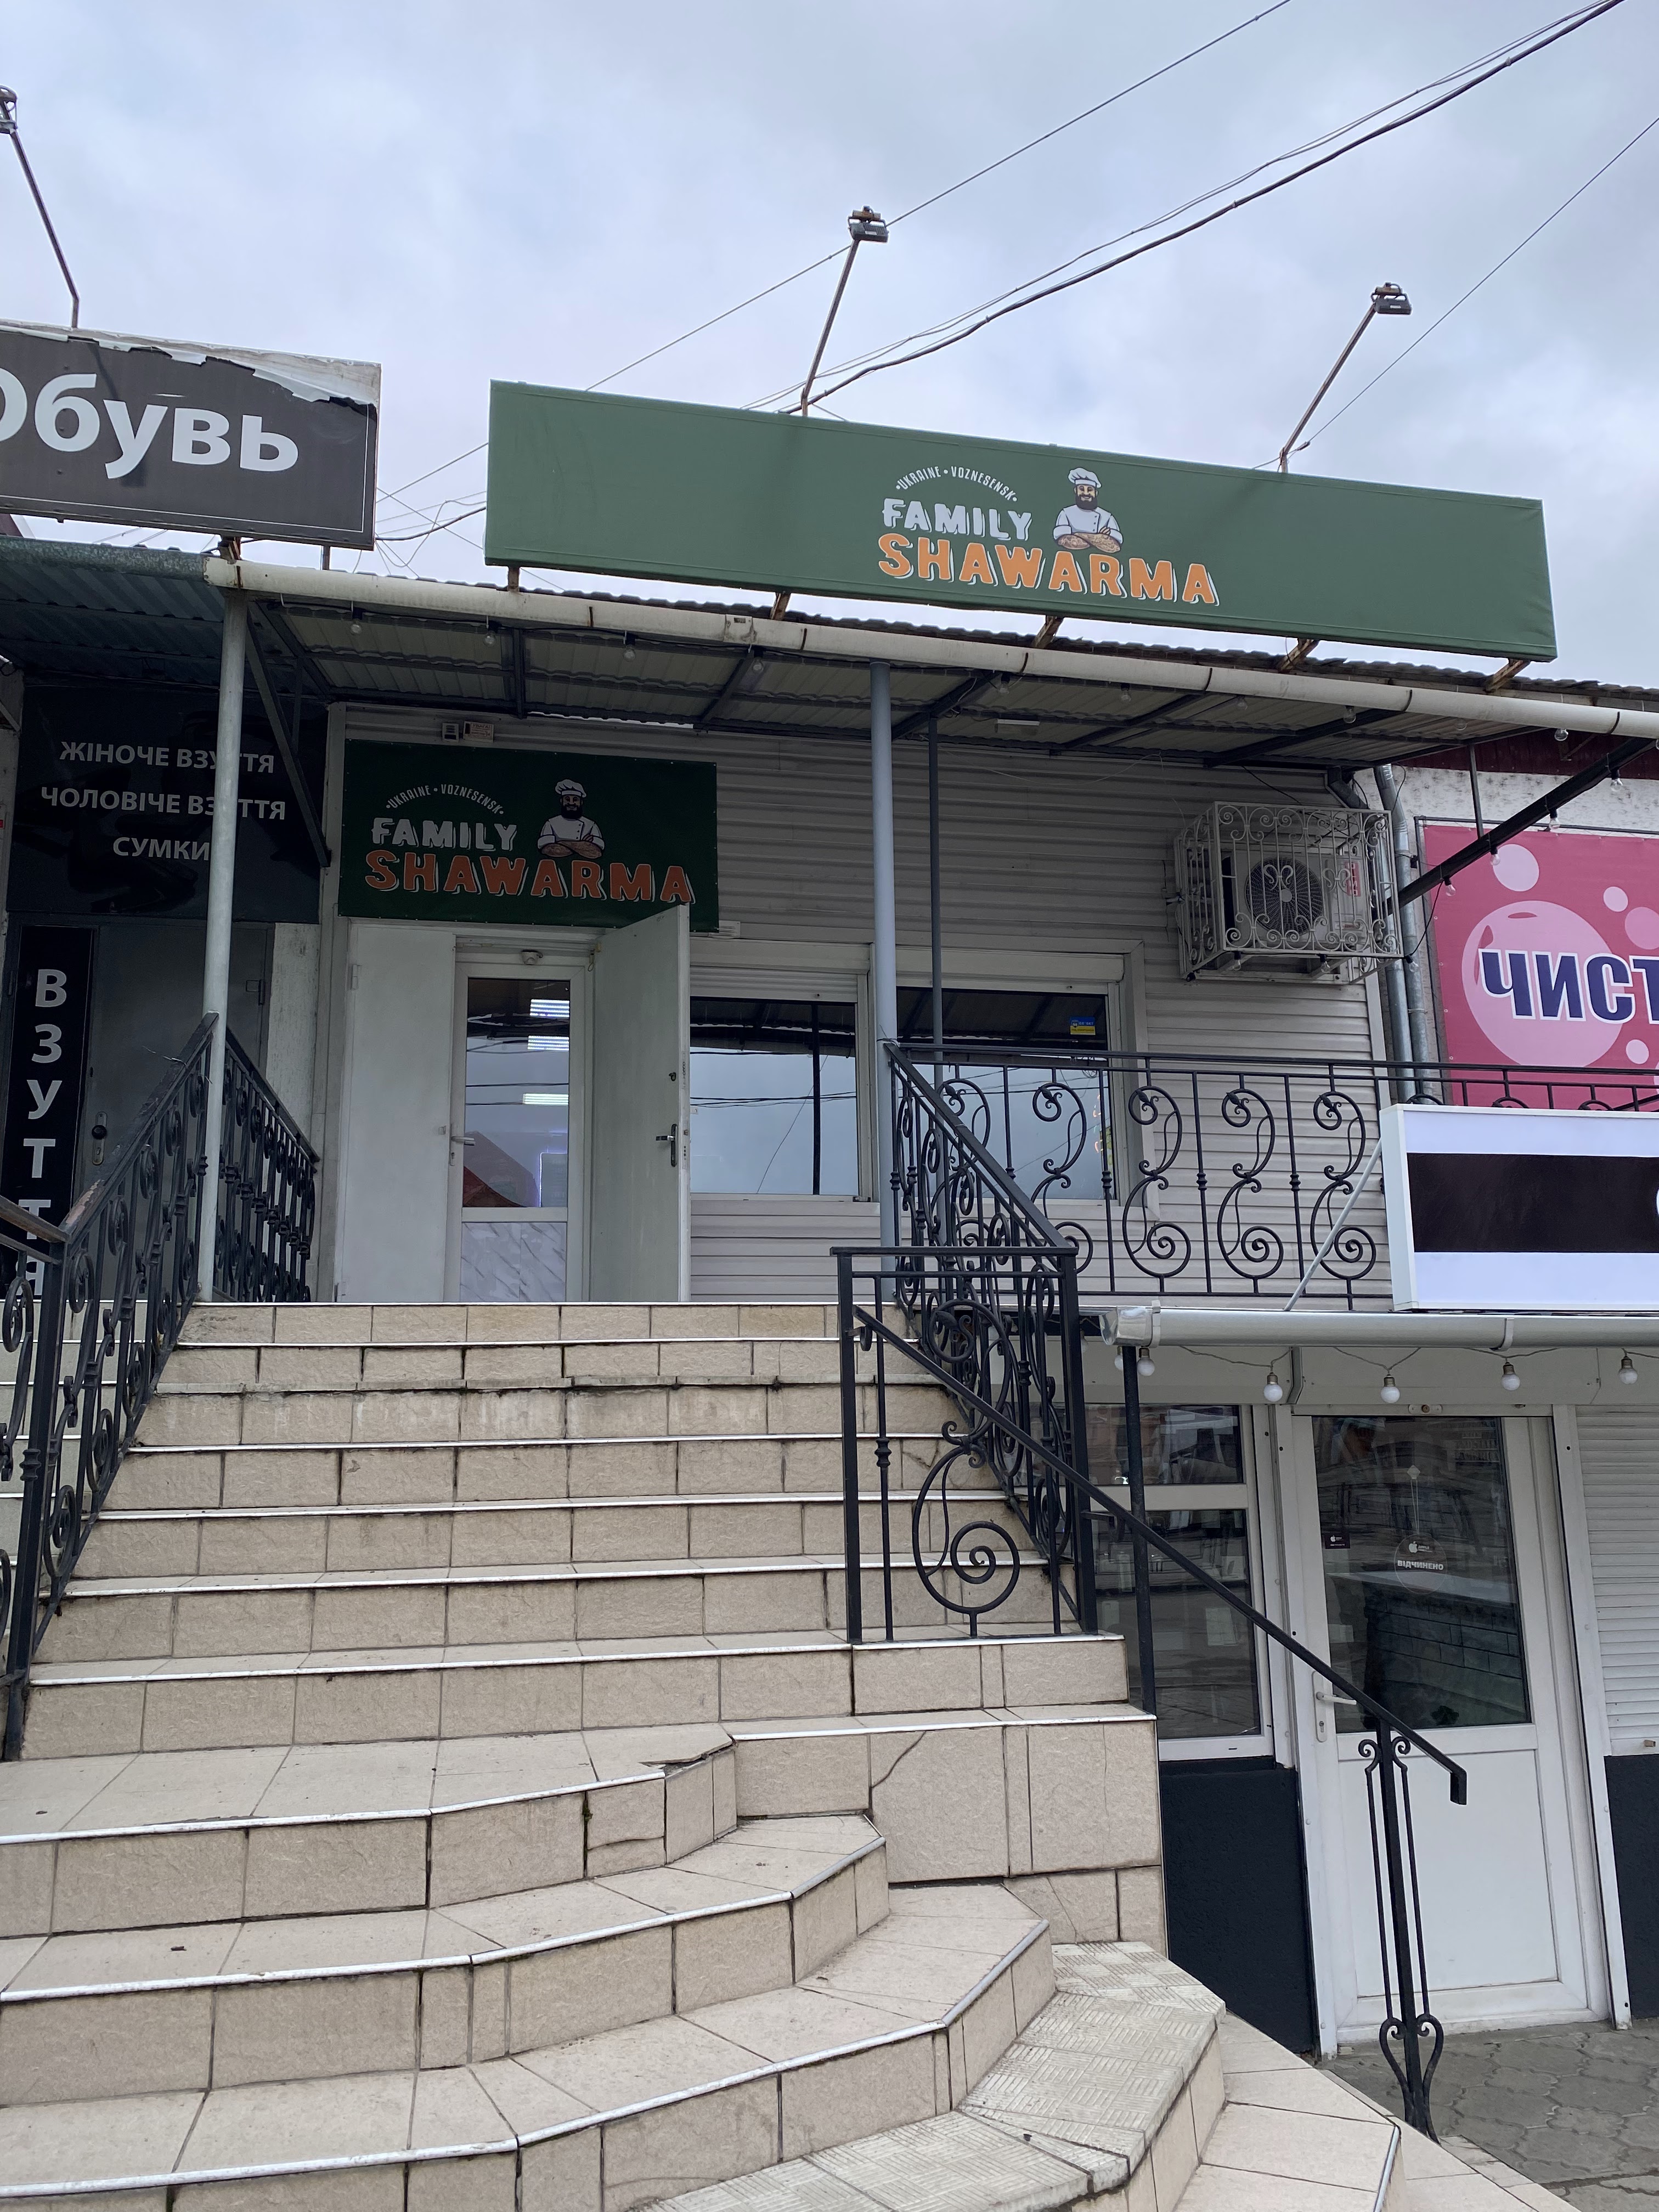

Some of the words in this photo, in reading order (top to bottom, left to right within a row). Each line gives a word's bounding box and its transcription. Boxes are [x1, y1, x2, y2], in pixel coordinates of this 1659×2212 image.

[897, 466, 941, 490] UKRAINE
[951, 466, 1016, 501] VOZNESENSK
[882, 498, 1032, 541] FAMILY
[878, 533, 1220, 606] SHAWARMA
[59, 741, 170, 767] ЖІНОЧЕ
[41, 786, 180, 814] ЧОЛОВІЧЕ
[188, 794, 286, 820] ВЗТТЯ
[387, 785, 431, 808] UKRAINE
[441, 784, 503, 814] VOZNESENSK
[113, 837, 210, 861] СУМКИ
[371, 817, 517, 851] FAMILY
[365, 849, 696, 904] SHAWARMA
[1397, 1560, 1444, 1570] ВІДЧИНЕНО
